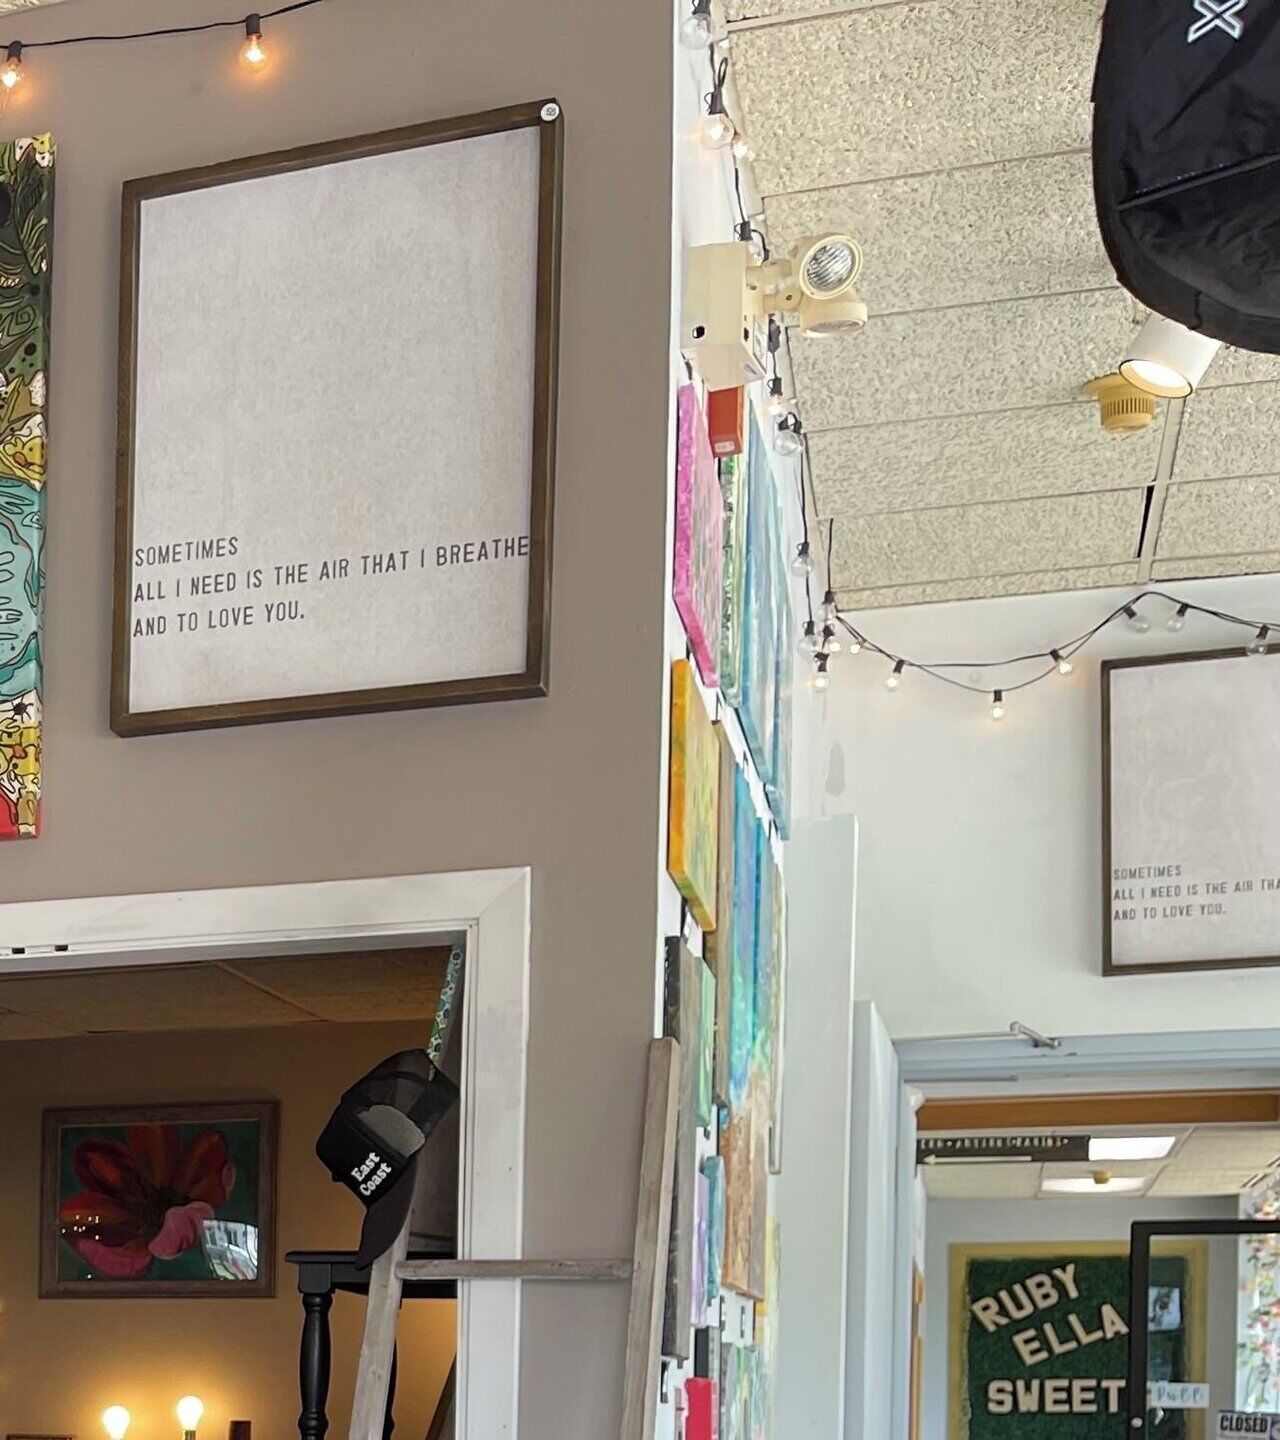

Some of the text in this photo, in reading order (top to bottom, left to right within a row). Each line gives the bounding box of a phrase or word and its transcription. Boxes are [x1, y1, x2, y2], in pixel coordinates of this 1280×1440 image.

[134, 536, 239, 568] SOMETIMES
[134, 535, 529, 602] ALL I NEED IS THE AIR THAT I BREATHE
[133, 600, 306, 637] AND TO LOVE YOU.
[1113, 864, 1182, 880] SOMETIMES
[1113, 888, 1135, 900] ALL
[1150, 885, 1182, 898] NEED
[1186, 884, 1199, 896] IS
[1205, 882, 1227, 895] THE
[1233, 880, 1254, 893] AIR
[1113, 903, 1227, 921] AND TO LOVE YOU.
[351, 1152, 380, 1182] East
[360, 1163, 392, 1196] Coast
[970, 1263, 1080, 1333] RUBY
[1012, 1303, 1130, 1367] ELLA
[987, 1378, 1127, 1415] SWEET
[1220, 1414, 1268, 1433] CLOSED
